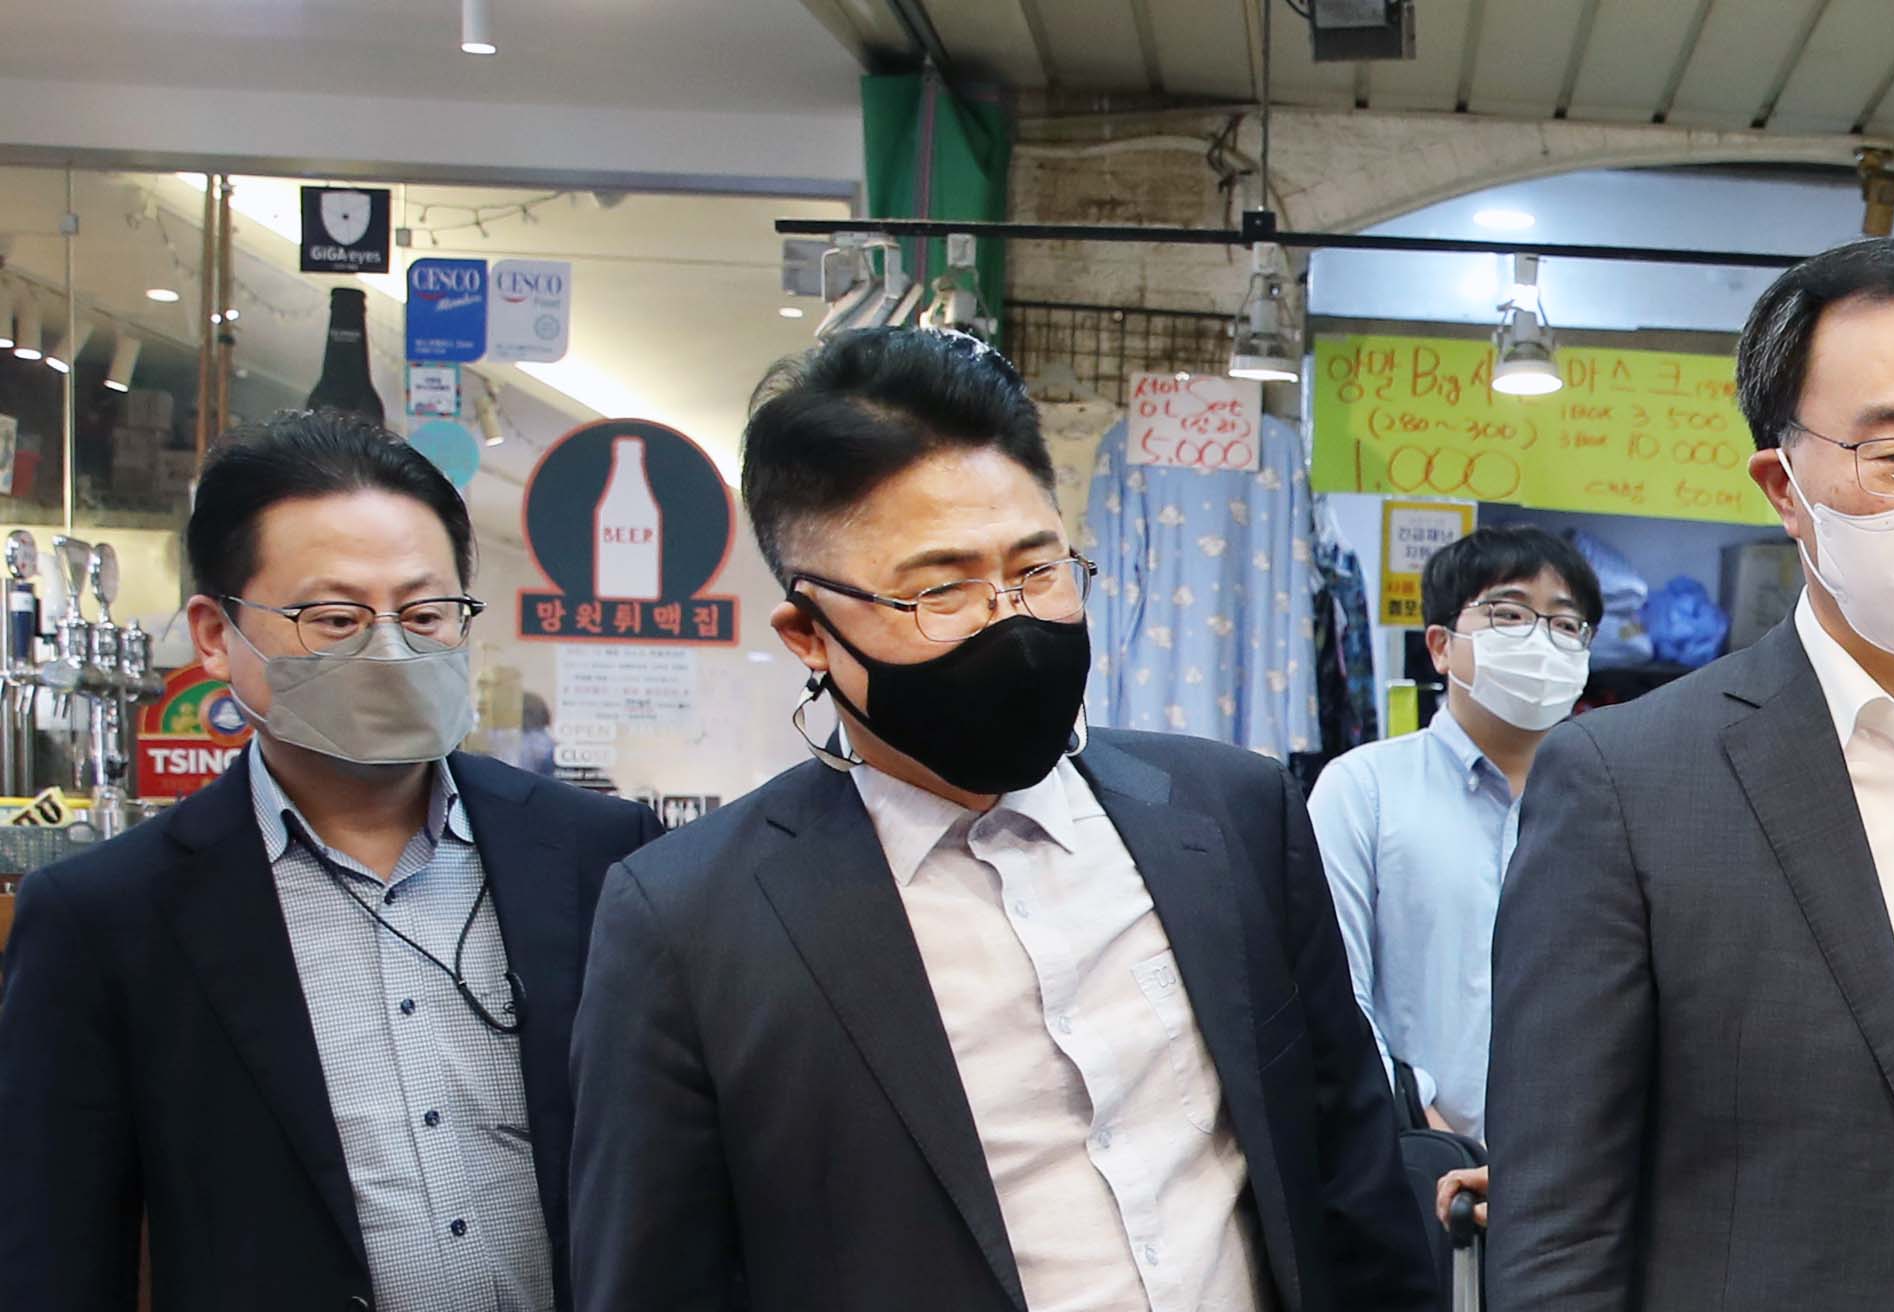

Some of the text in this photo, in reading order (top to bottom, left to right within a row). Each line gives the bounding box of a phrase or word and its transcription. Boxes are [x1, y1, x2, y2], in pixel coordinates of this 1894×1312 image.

[411, 266, 480, 291] CESCO
[497, 270, 562, 295] CESCO
[1142, 427, 1252, 469] 5.000
[603, 527, 654, 544] BEER
